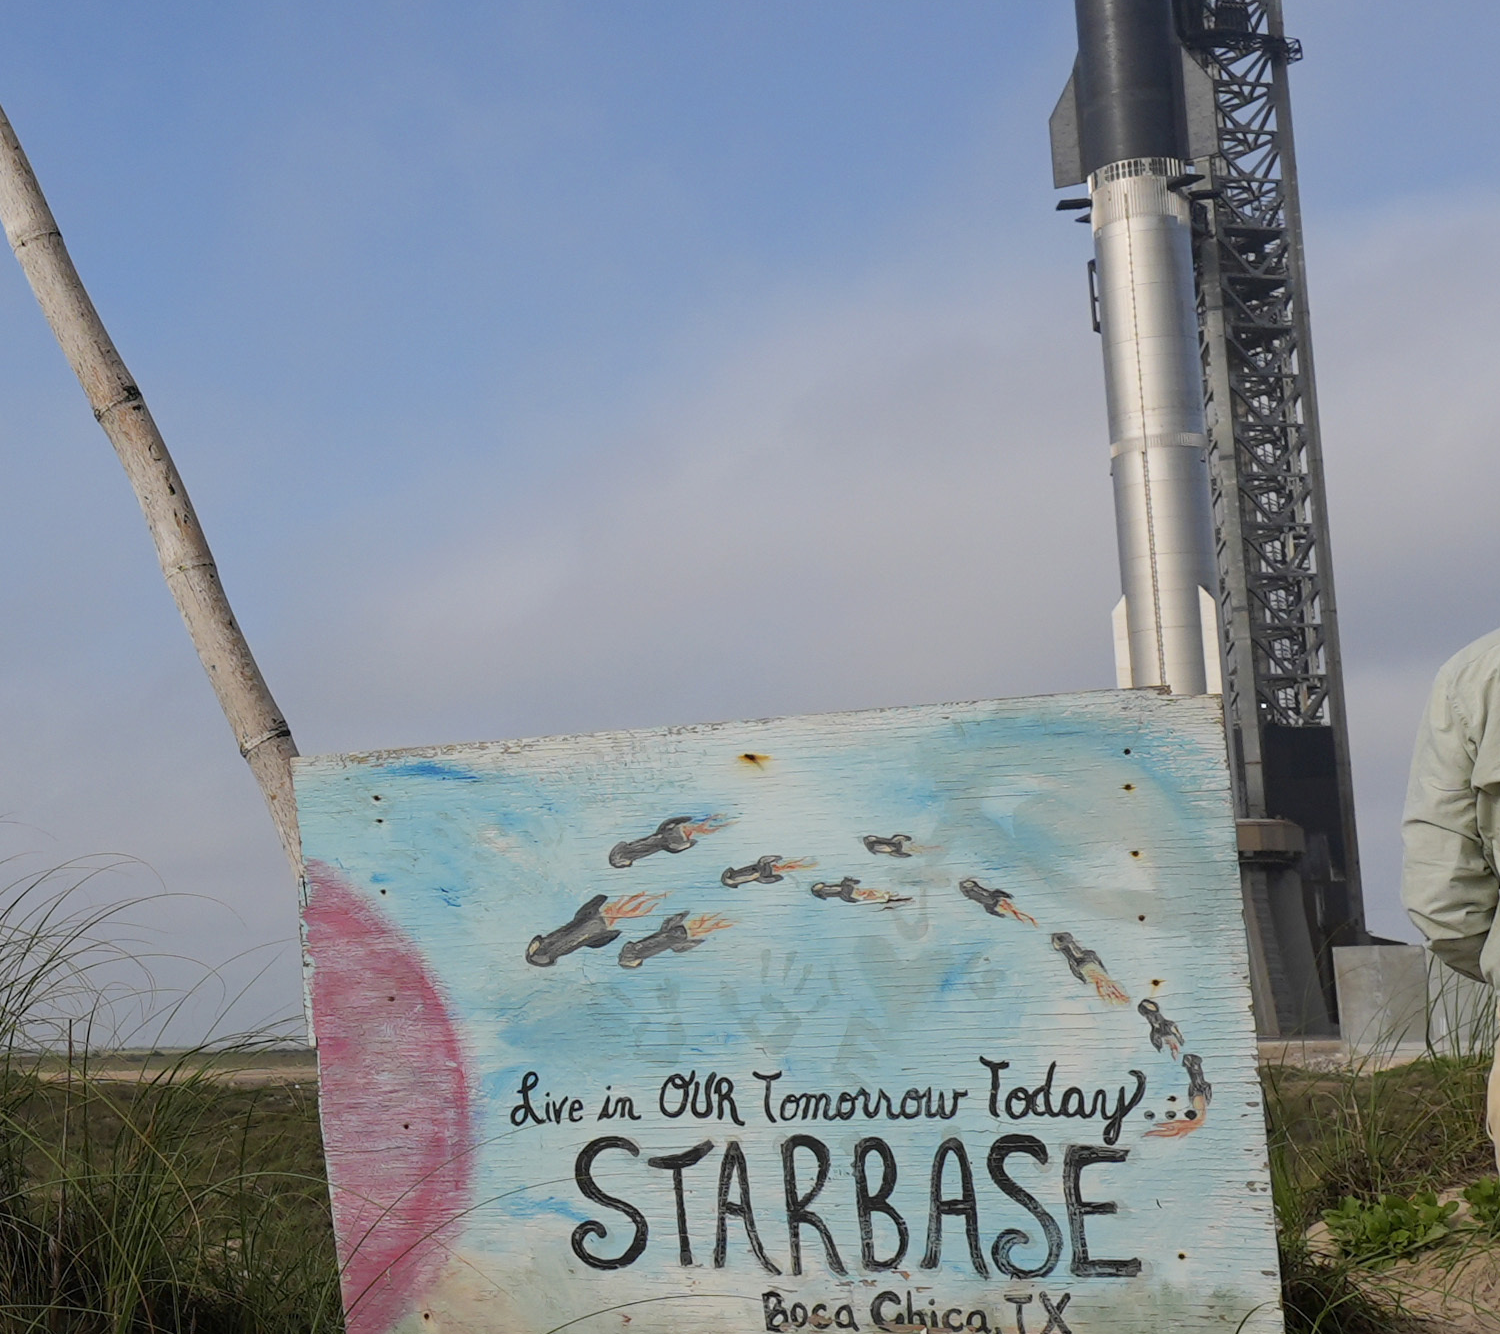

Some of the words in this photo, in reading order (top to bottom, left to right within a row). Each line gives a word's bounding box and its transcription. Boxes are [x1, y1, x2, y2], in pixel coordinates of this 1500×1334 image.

[510, 1070, 585, 1127] Live
[596, 1085, 642, 1122] in
[659, 1069, 746, 1127] OUR
[752, 1070, 968, 1124] Tomorrow
[570, 1133, 1143, 1280] STARBASE
[761, 1289, 861, 1334] Boca
